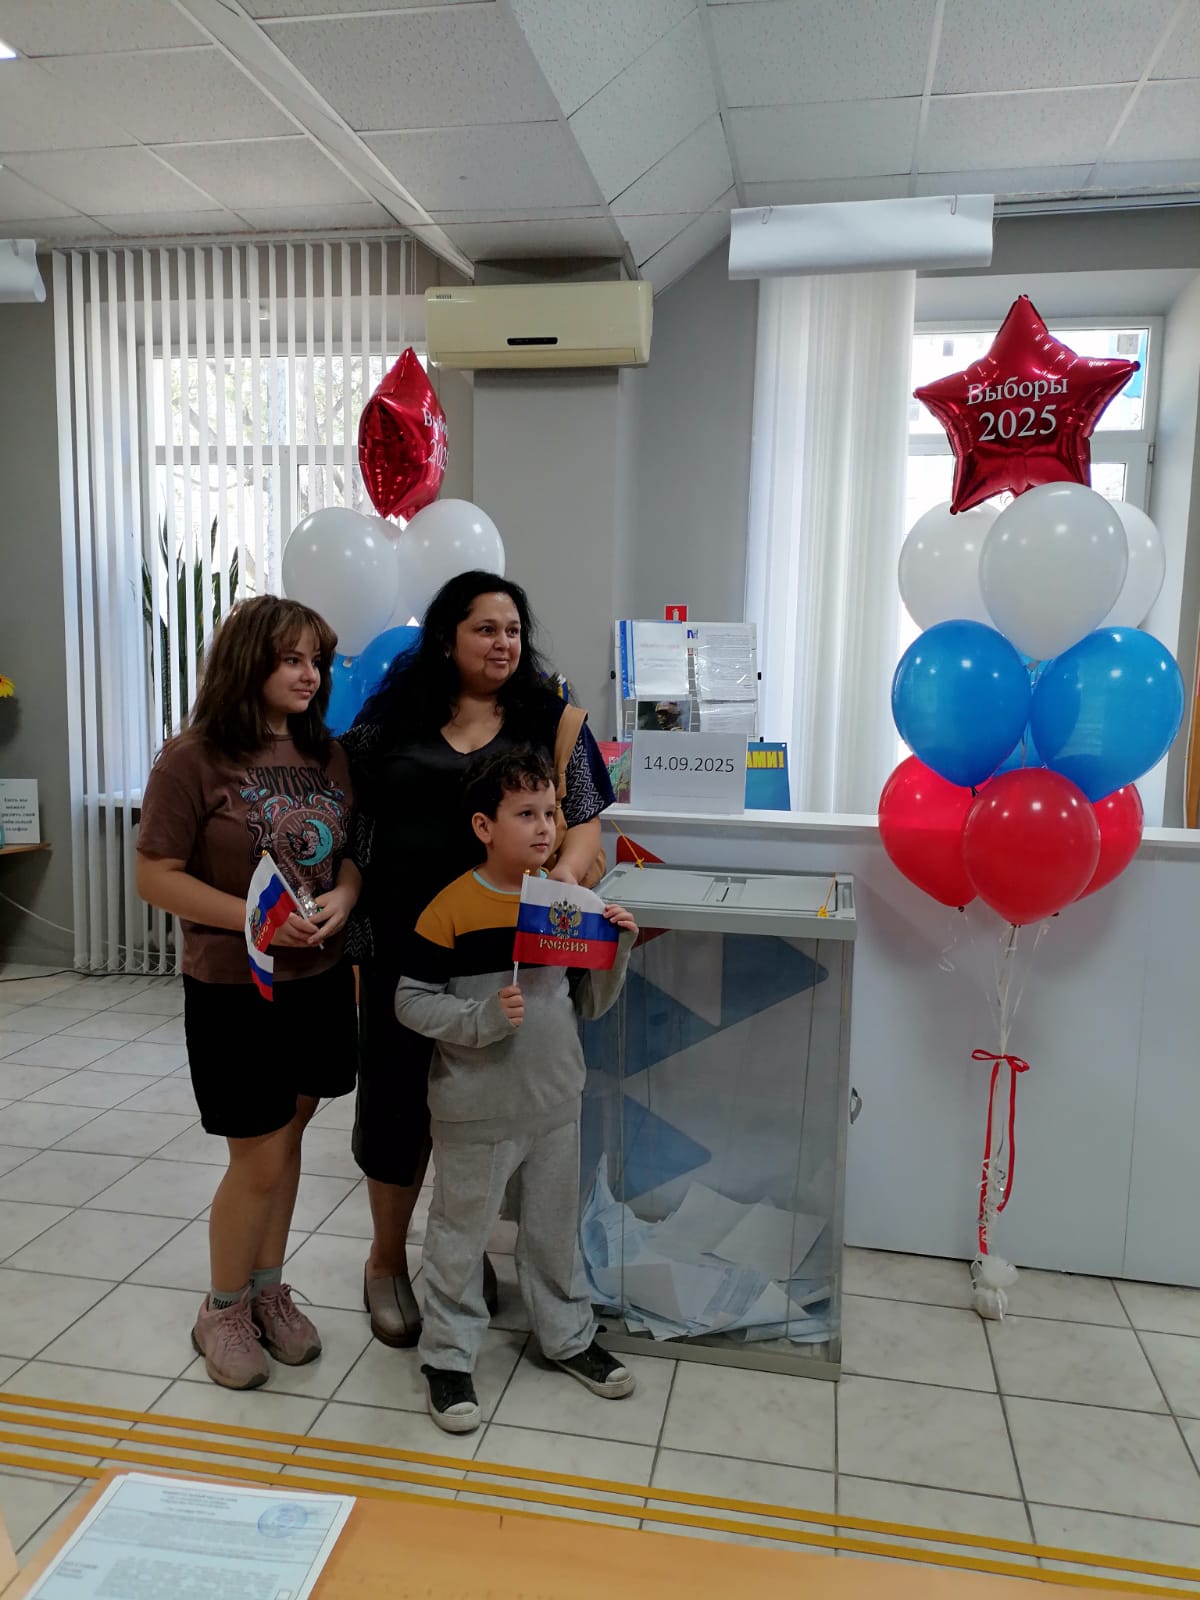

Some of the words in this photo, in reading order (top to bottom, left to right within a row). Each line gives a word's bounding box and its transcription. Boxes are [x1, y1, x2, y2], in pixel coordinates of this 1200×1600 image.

[967, 376, 1069, 405] Выборы
[979, 404, 1057, 441] 2025
[643, 755, 735, 773] 14.09.2025
[246, 766, 331, 798] FANTASTIC
[539, 938, 588, 953] РОССИЯ
